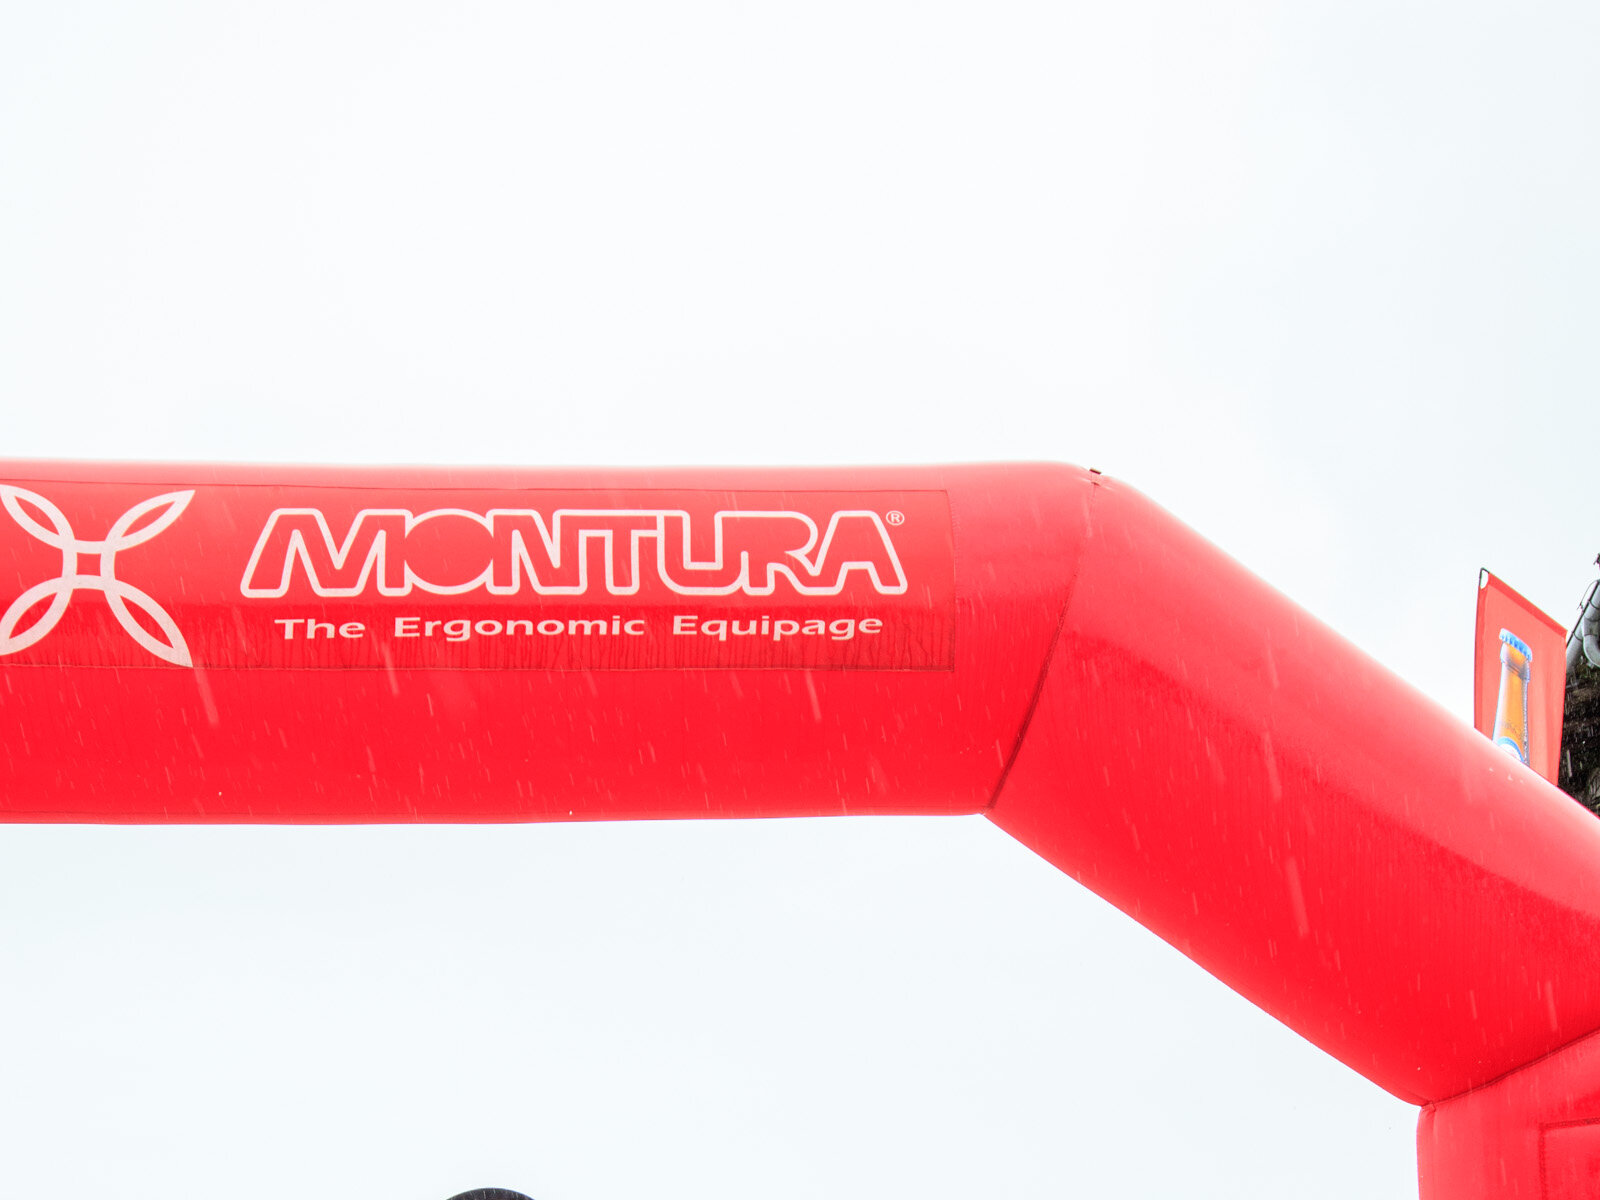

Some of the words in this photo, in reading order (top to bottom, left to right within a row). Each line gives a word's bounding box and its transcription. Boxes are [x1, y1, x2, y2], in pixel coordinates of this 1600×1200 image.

[274, 618, 366, 640] The
[394, 615, 645, 642] Ergonomic
[673, 614, 884, 642] Equipage
